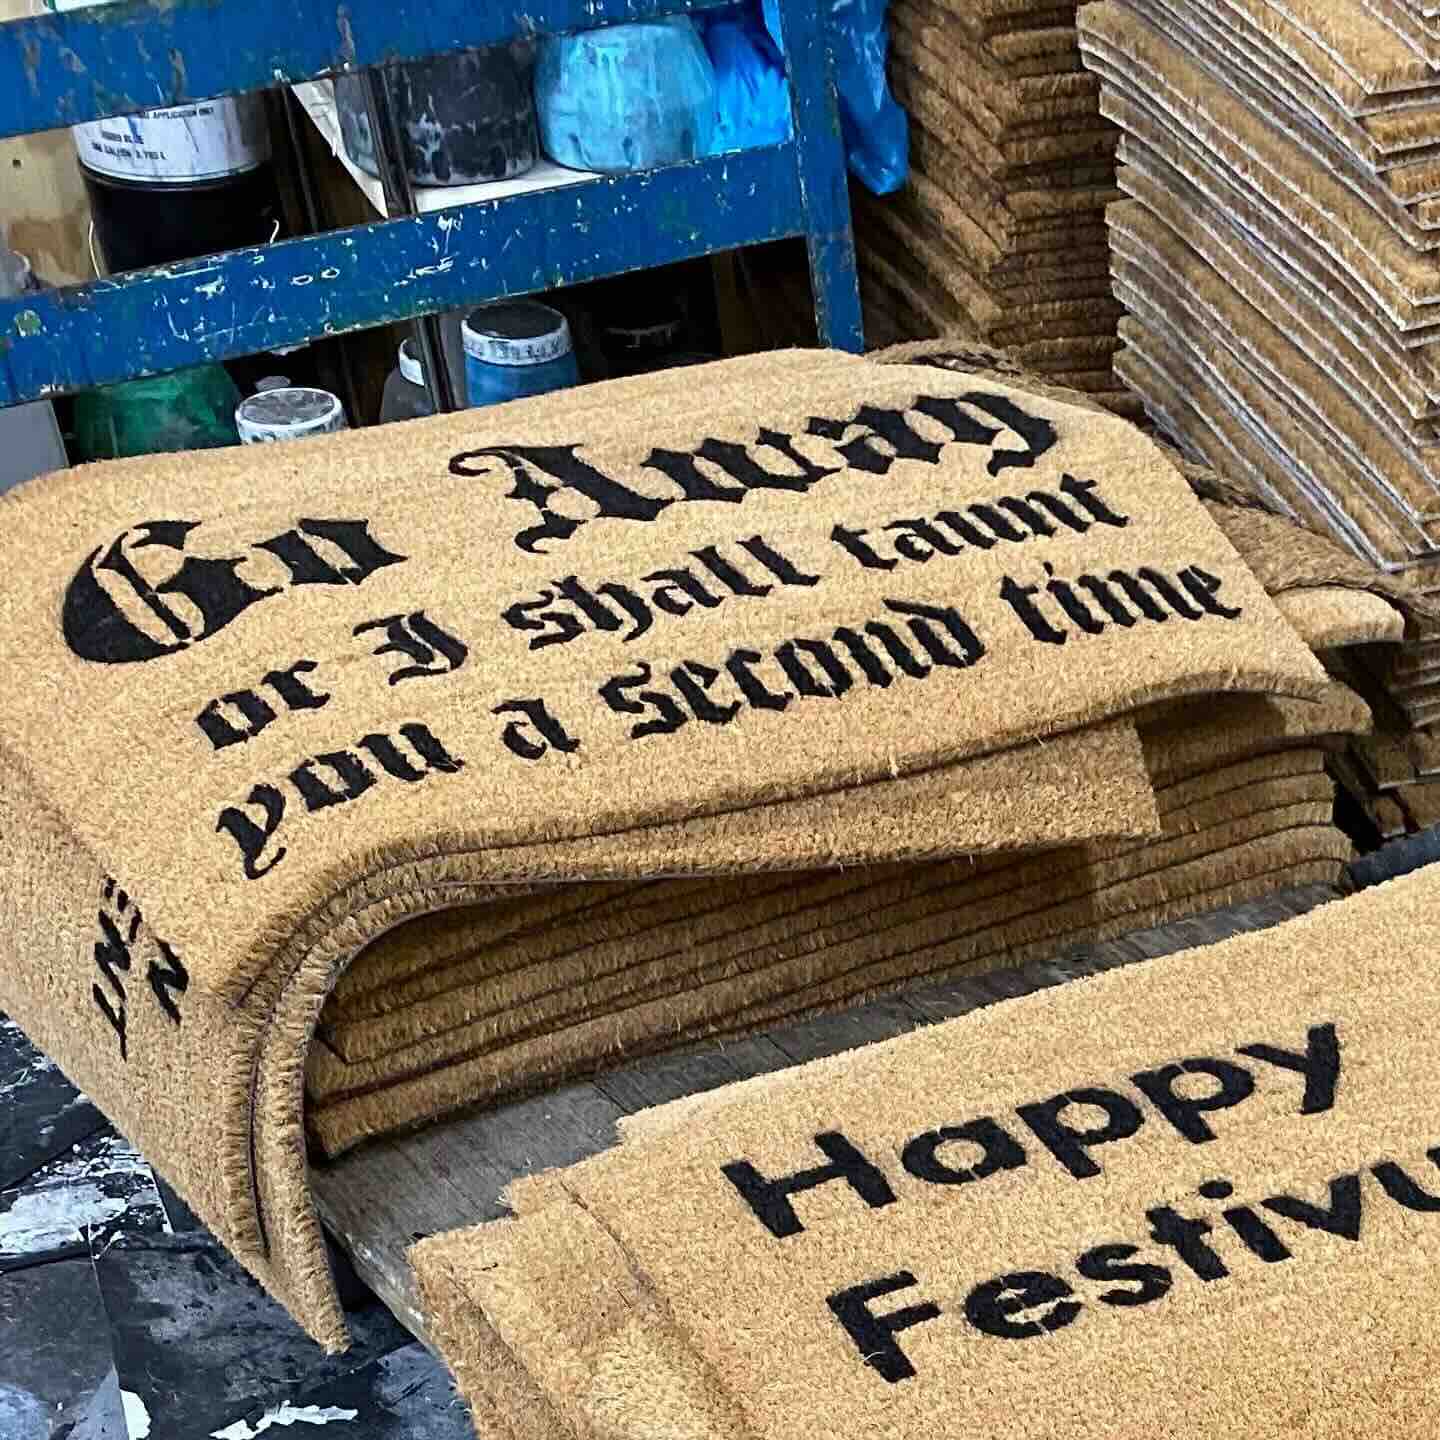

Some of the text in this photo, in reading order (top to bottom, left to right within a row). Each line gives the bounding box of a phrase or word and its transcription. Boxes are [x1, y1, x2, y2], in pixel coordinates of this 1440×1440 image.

[62, 389, 1060, 665] Go Away
[196, 468, 1128, 750] or I shall taunt
[215, 562, 1242, 880] you a second time
[721, 1023, 1340, 1239] Happy
